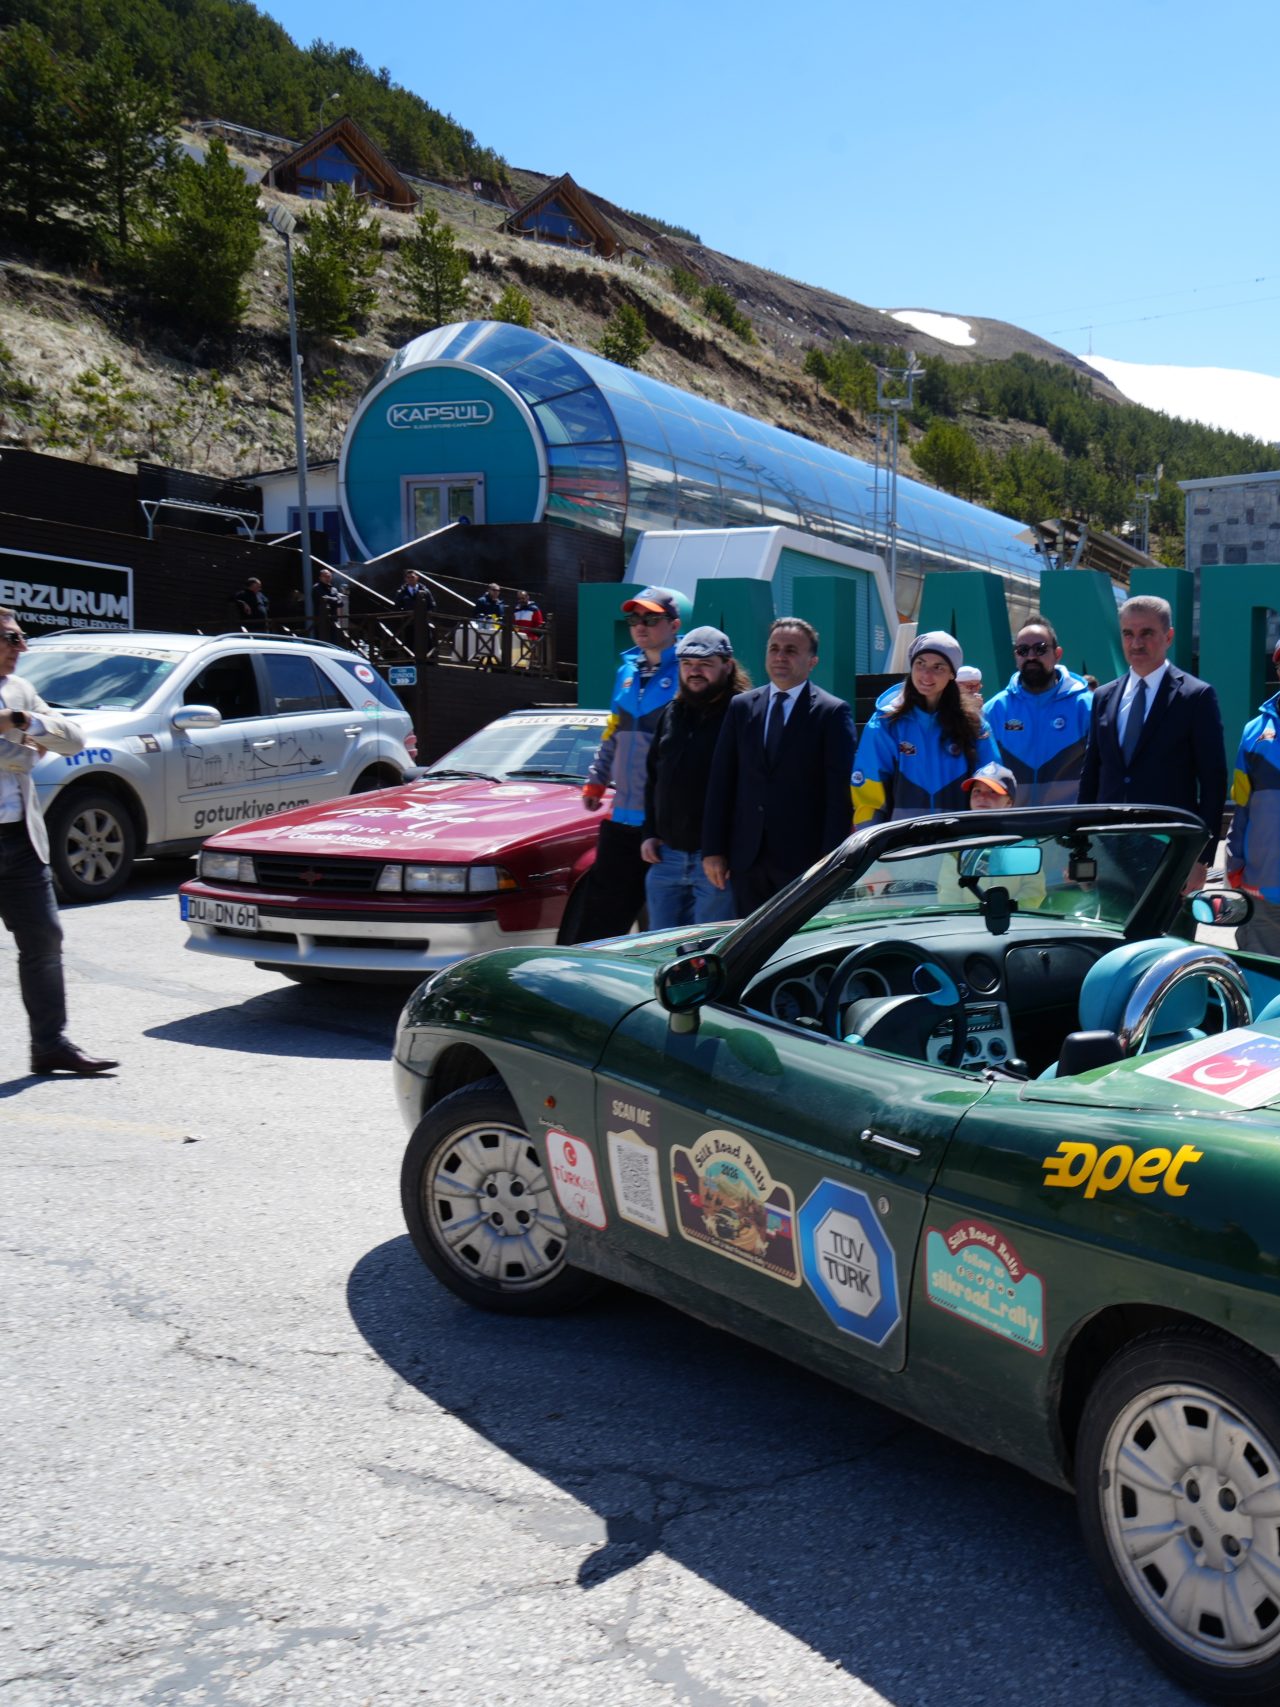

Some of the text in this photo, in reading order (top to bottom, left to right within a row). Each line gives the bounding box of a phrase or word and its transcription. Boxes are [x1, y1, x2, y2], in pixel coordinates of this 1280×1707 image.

[0, 579, 129, 619] ERZURUM
[215, 903, 234, 924] DN
[237, 906, 256, 928] 6H
[1041, 1141, 1204, 1199] Opet
[829, 1229, 864, 1264] TÜV
